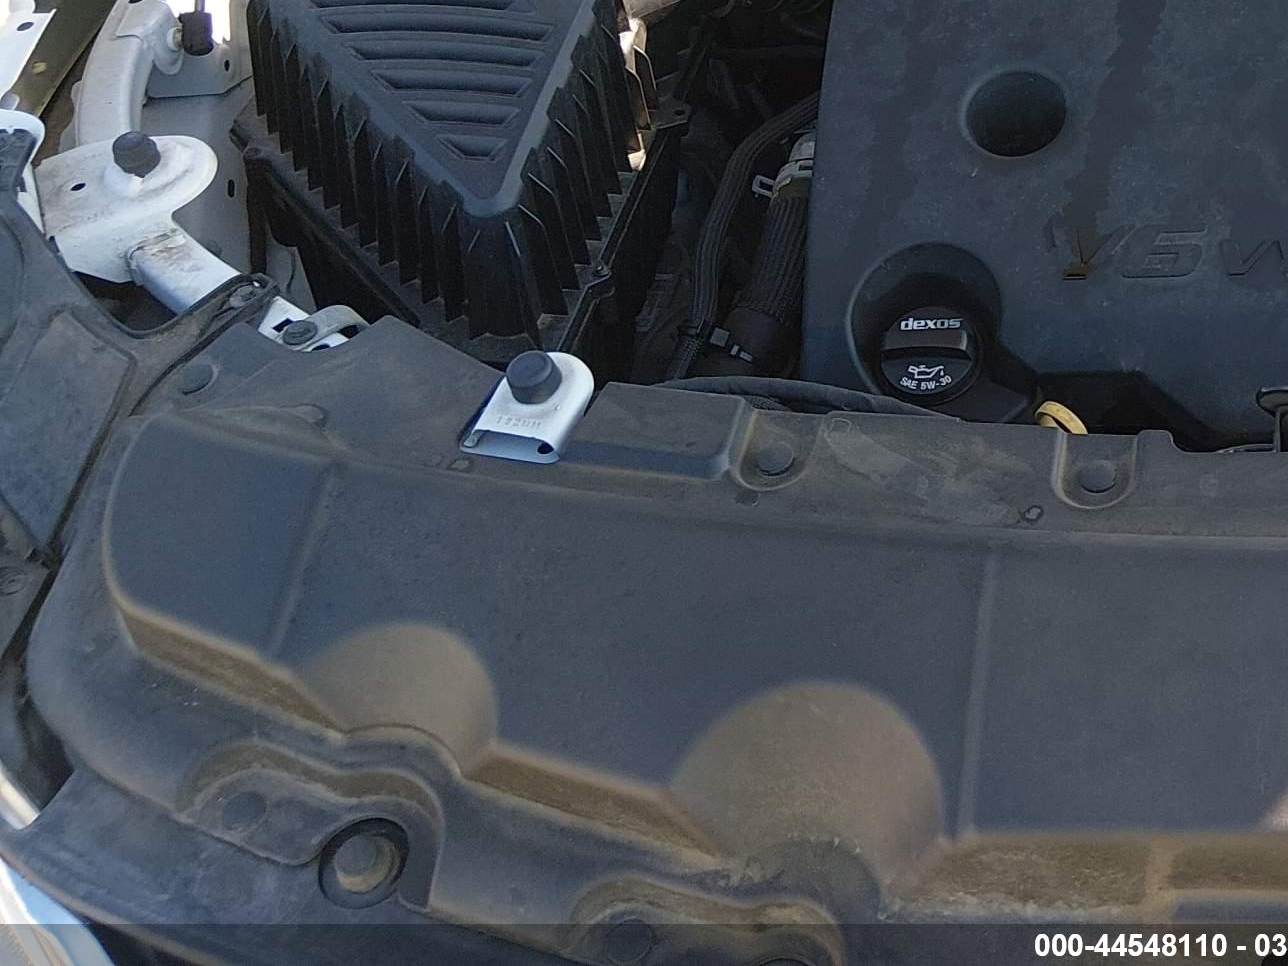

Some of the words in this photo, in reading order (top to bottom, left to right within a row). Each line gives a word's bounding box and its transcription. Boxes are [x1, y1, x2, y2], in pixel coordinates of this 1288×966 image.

[1047, 224, 1207, 282] V6
[900, 317, 963, 330] dexos
[900, 376, 919, 390] SAE
[920, 375, 952, 391] 5W-30
